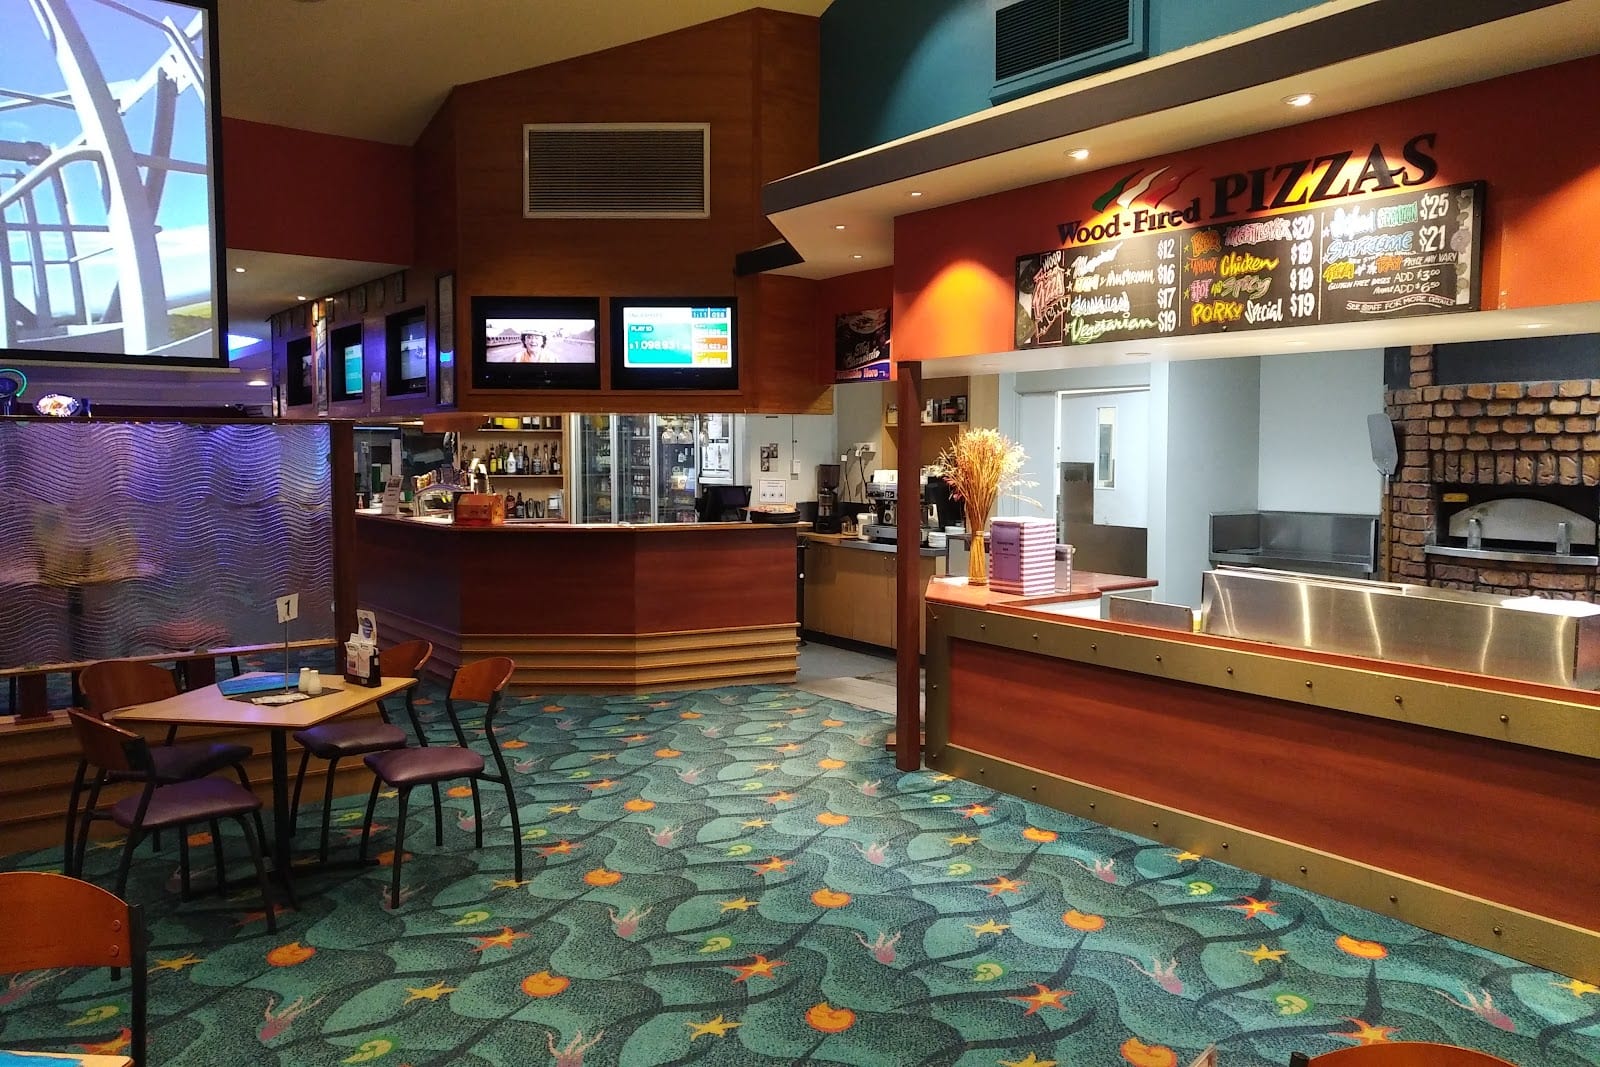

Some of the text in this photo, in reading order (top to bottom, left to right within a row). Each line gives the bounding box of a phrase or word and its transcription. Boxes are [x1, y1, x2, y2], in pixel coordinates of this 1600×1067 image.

[1210, 132, 1440, 219] PIZZAS
[1420, 192, 1449, 221] $25
[1056, 197, 1201, 245] Wood-Fired
[1292, 214, 1315, 241] $20
[1157, 239, 1175, 260] $12
[1327, 231, 1415, 264] SUPREME
[1419, 225, 1446, 252] $21
[1157, 264, 1175, 285] $16
[1221, 251, 1280, 277] Chicken
[1290, 266, 1314, 291] $19
[1353, 279, 1370, 288] FREE
[1394, 271, 1414, 283] ADD
[1393, 284, 1414, 294] ADD
[1157, 286, 1176, 308] $17
[1384, 299, 1402, 310] FOR
[1403, 295, 1427, 305] MORE
[1191, 300, 1245, 326] PORKY
[1290, 292, 1315, 317] $19
[1157, 310, 1177, 332] $19
[284, 599, 290, 617] 1
